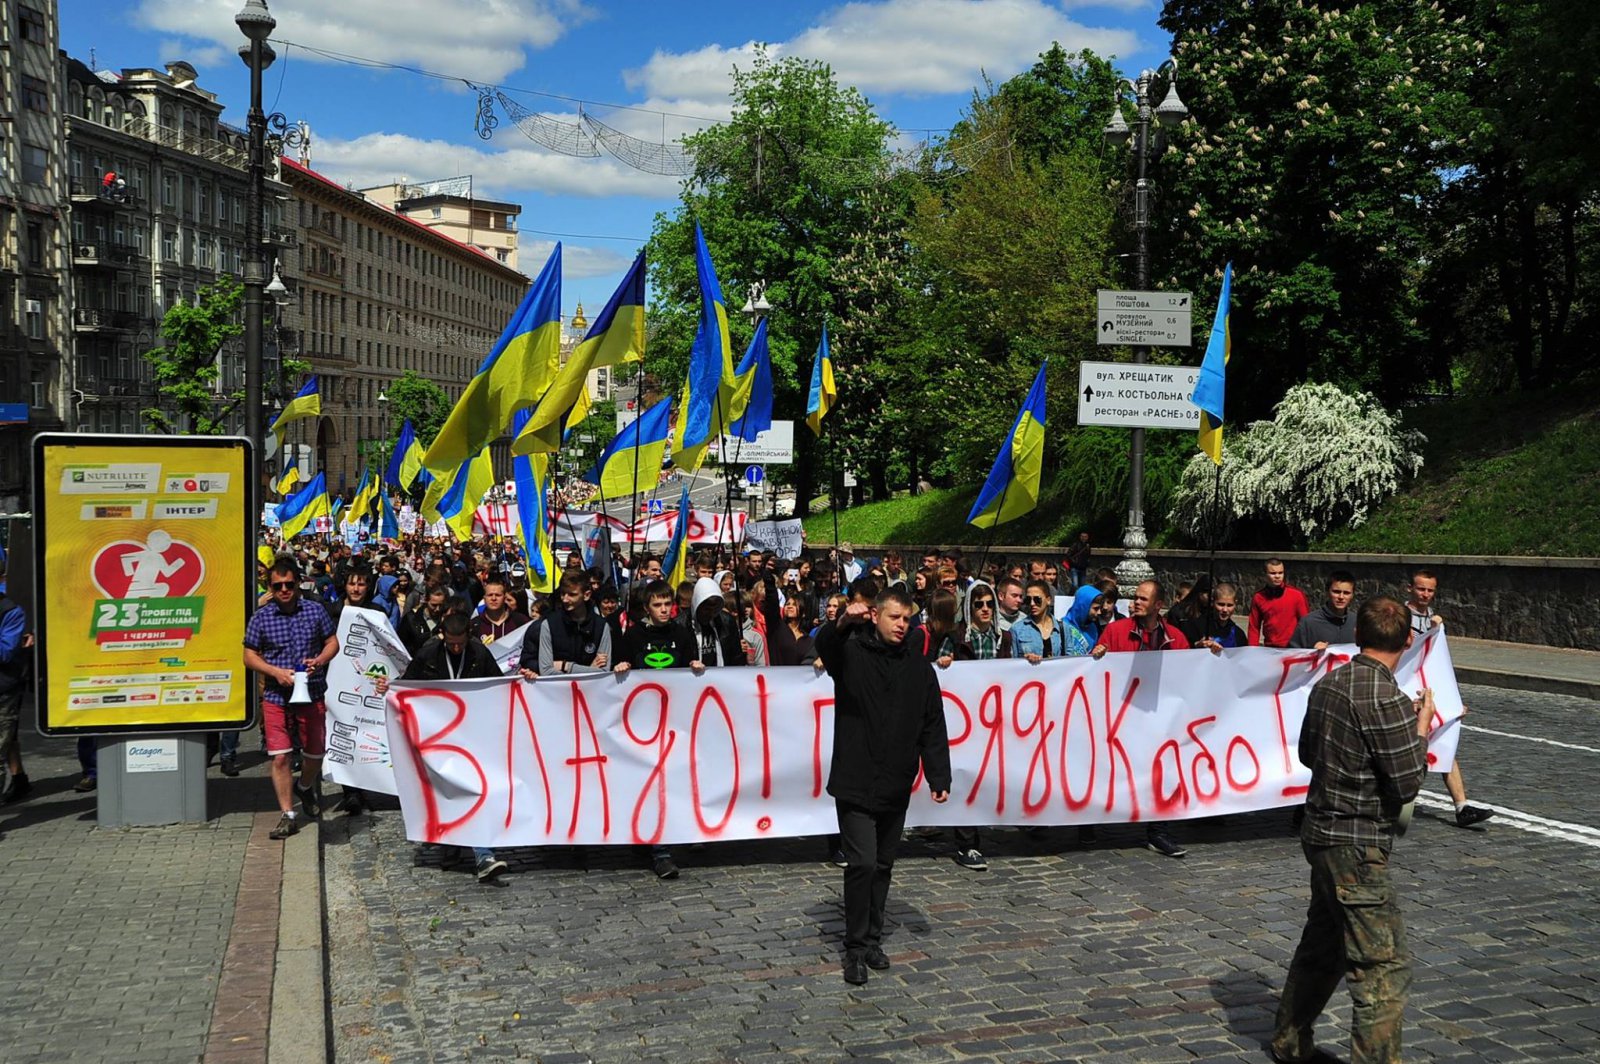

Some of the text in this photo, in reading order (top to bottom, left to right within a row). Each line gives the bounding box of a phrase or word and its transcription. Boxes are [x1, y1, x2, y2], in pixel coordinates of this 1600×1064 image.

[1115, 319, 1153, 327] МУЗЕЙНИЙ
[1096, 372, 1115, 382] вул.
[1119, 372, 1174, 383] ХРЕЩАТИК
[1095, 390, 1114, 399] вул.
[1118, 389, 1183, 401] КОСТЬОЛЬНА
[1094, 408, 1139, 419] ресторан
[1186, 410, 1199, 420] 0,8
[87, 472, 147, 480] NUTRILITE
[166, 507, 206, 515] ІНТЕР
[141, 608, 192, 617] ПРОБІГ ПІД
[140, 617, 199, 626] КАШТАНАМИ
[130, 632, 166, 640] ЧЕРВНЯ
[1151, 715, 1260, 815] або
